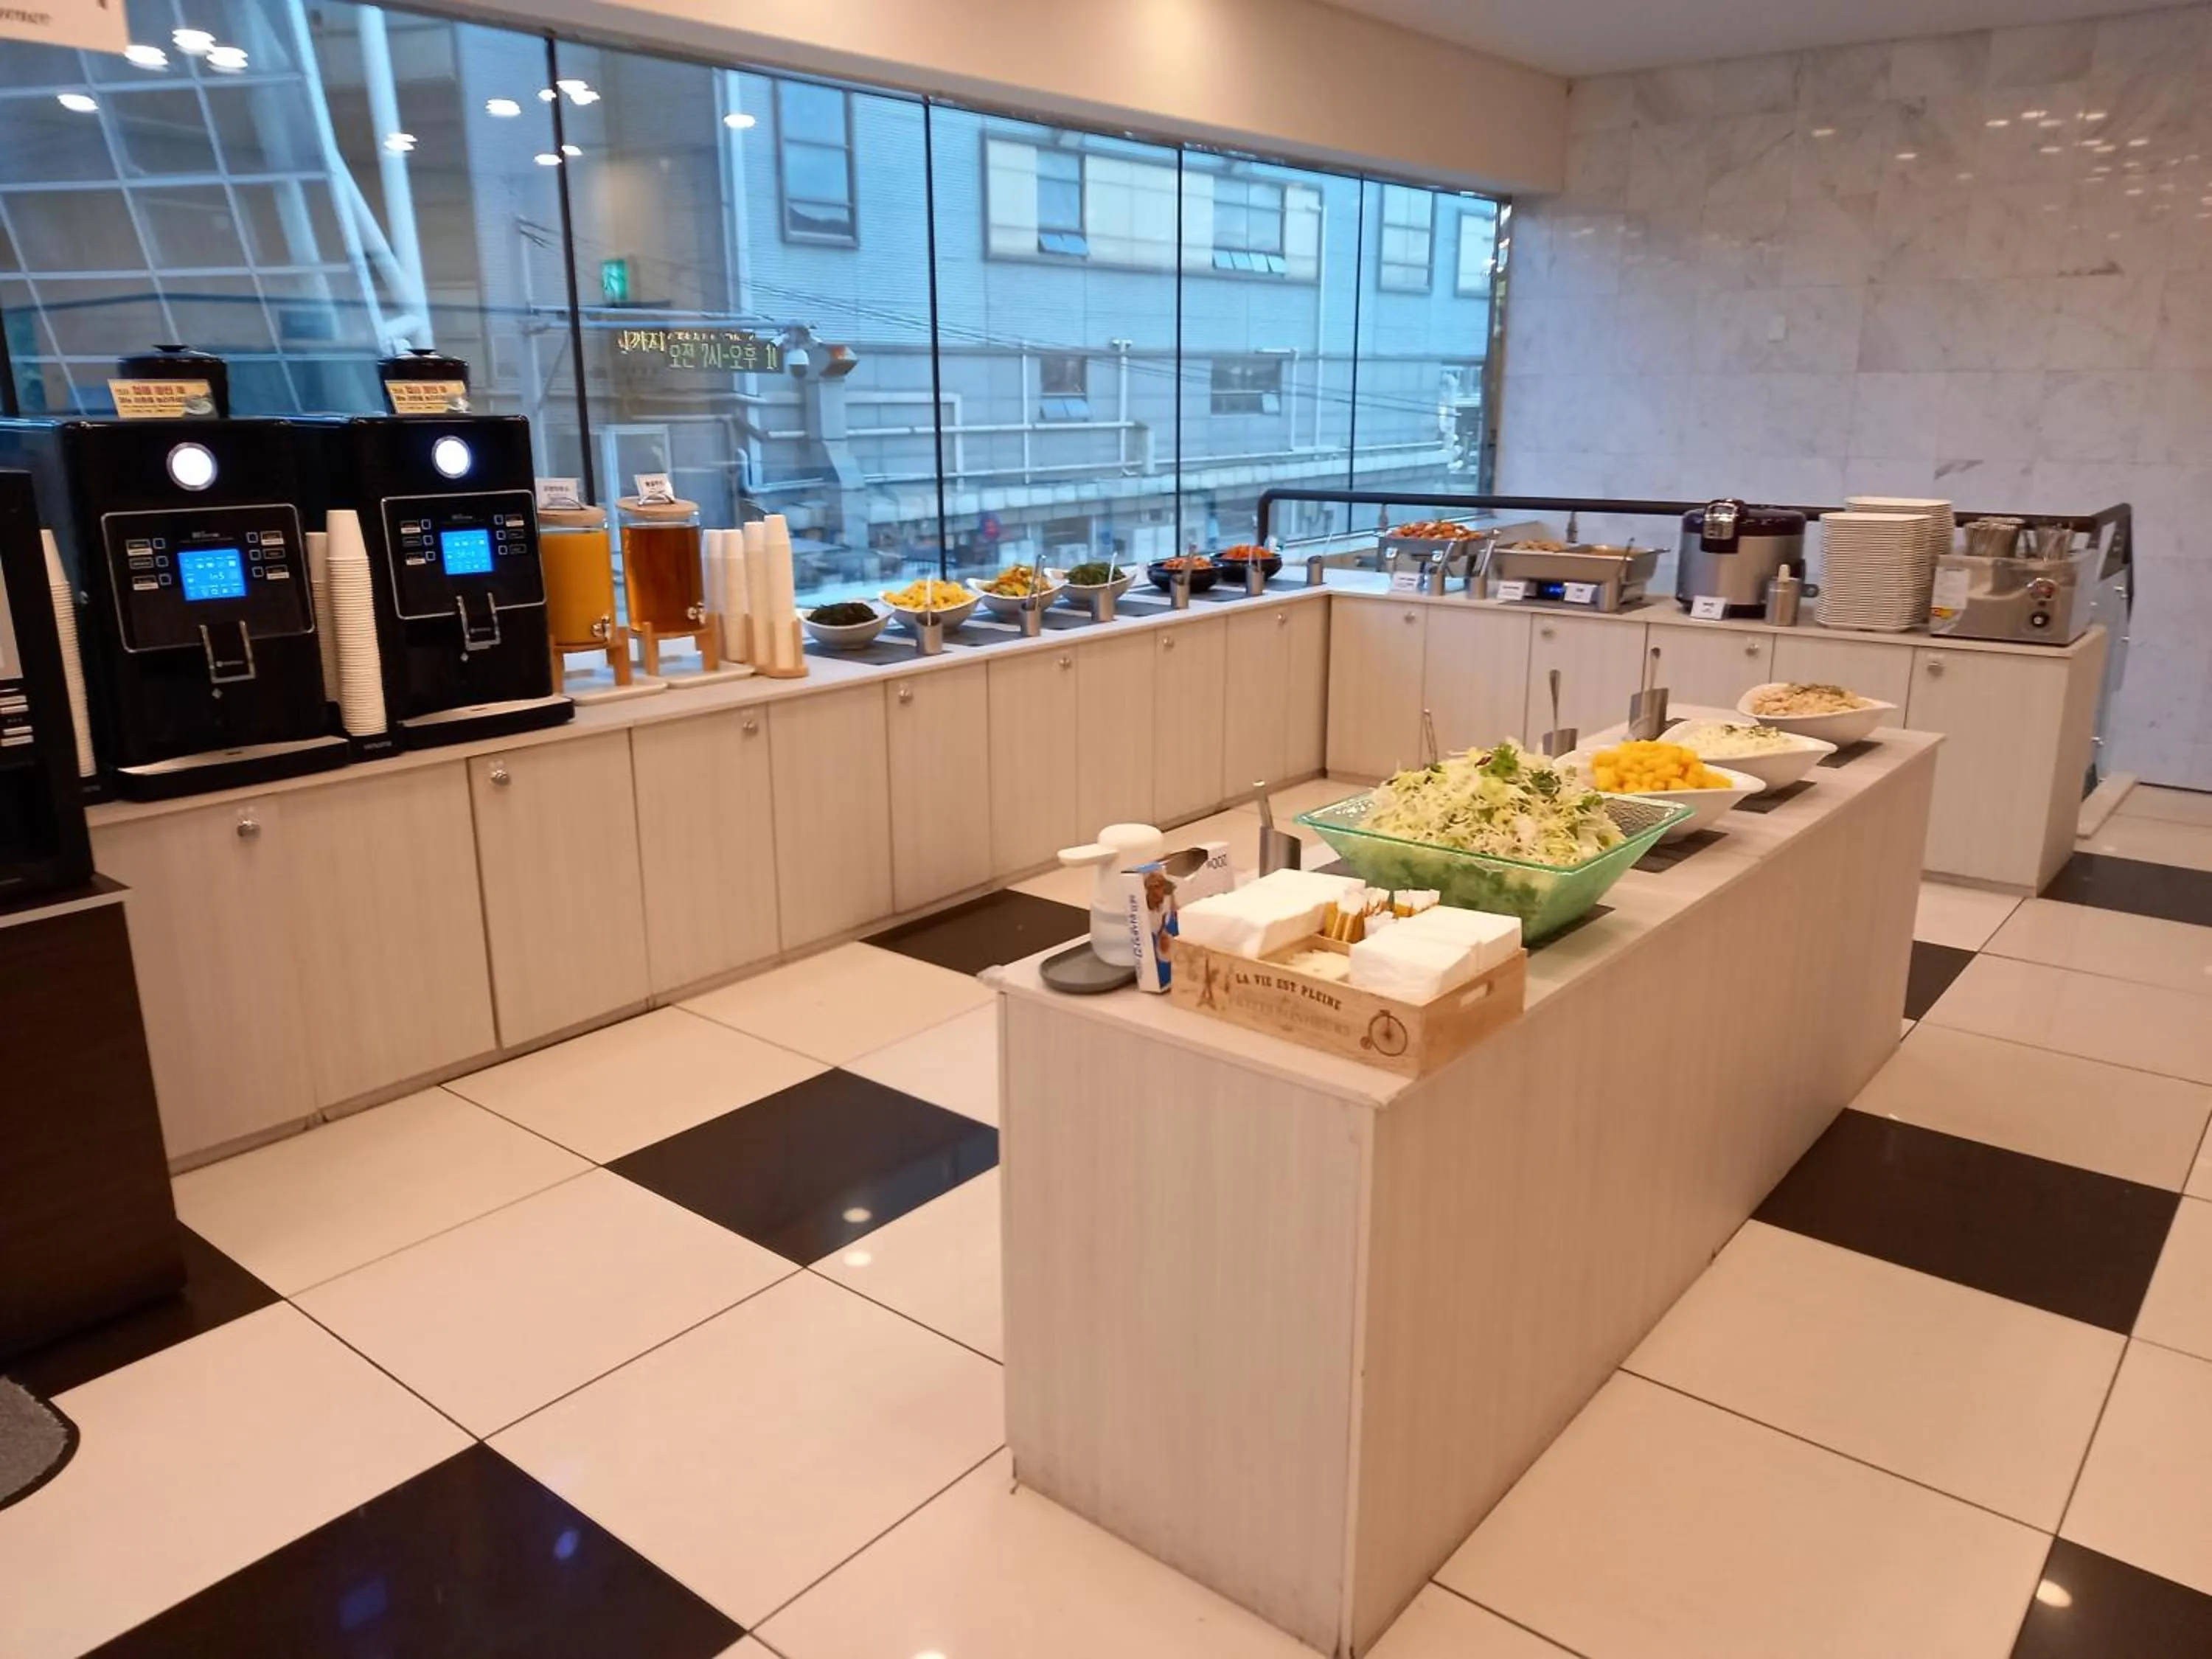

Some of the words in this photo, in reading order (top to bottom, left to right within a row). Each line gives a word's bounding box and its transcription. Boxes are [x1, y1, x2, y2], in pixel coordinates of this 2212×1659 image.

[669, 343, 695, 368] 오전
[1236, 973, 1250, 984] LA
[1254, 974, 1272, 987] VIE
[1276, 978, 1297, 992] EST
[1301, 985, 1342, 1011] PLEINE
